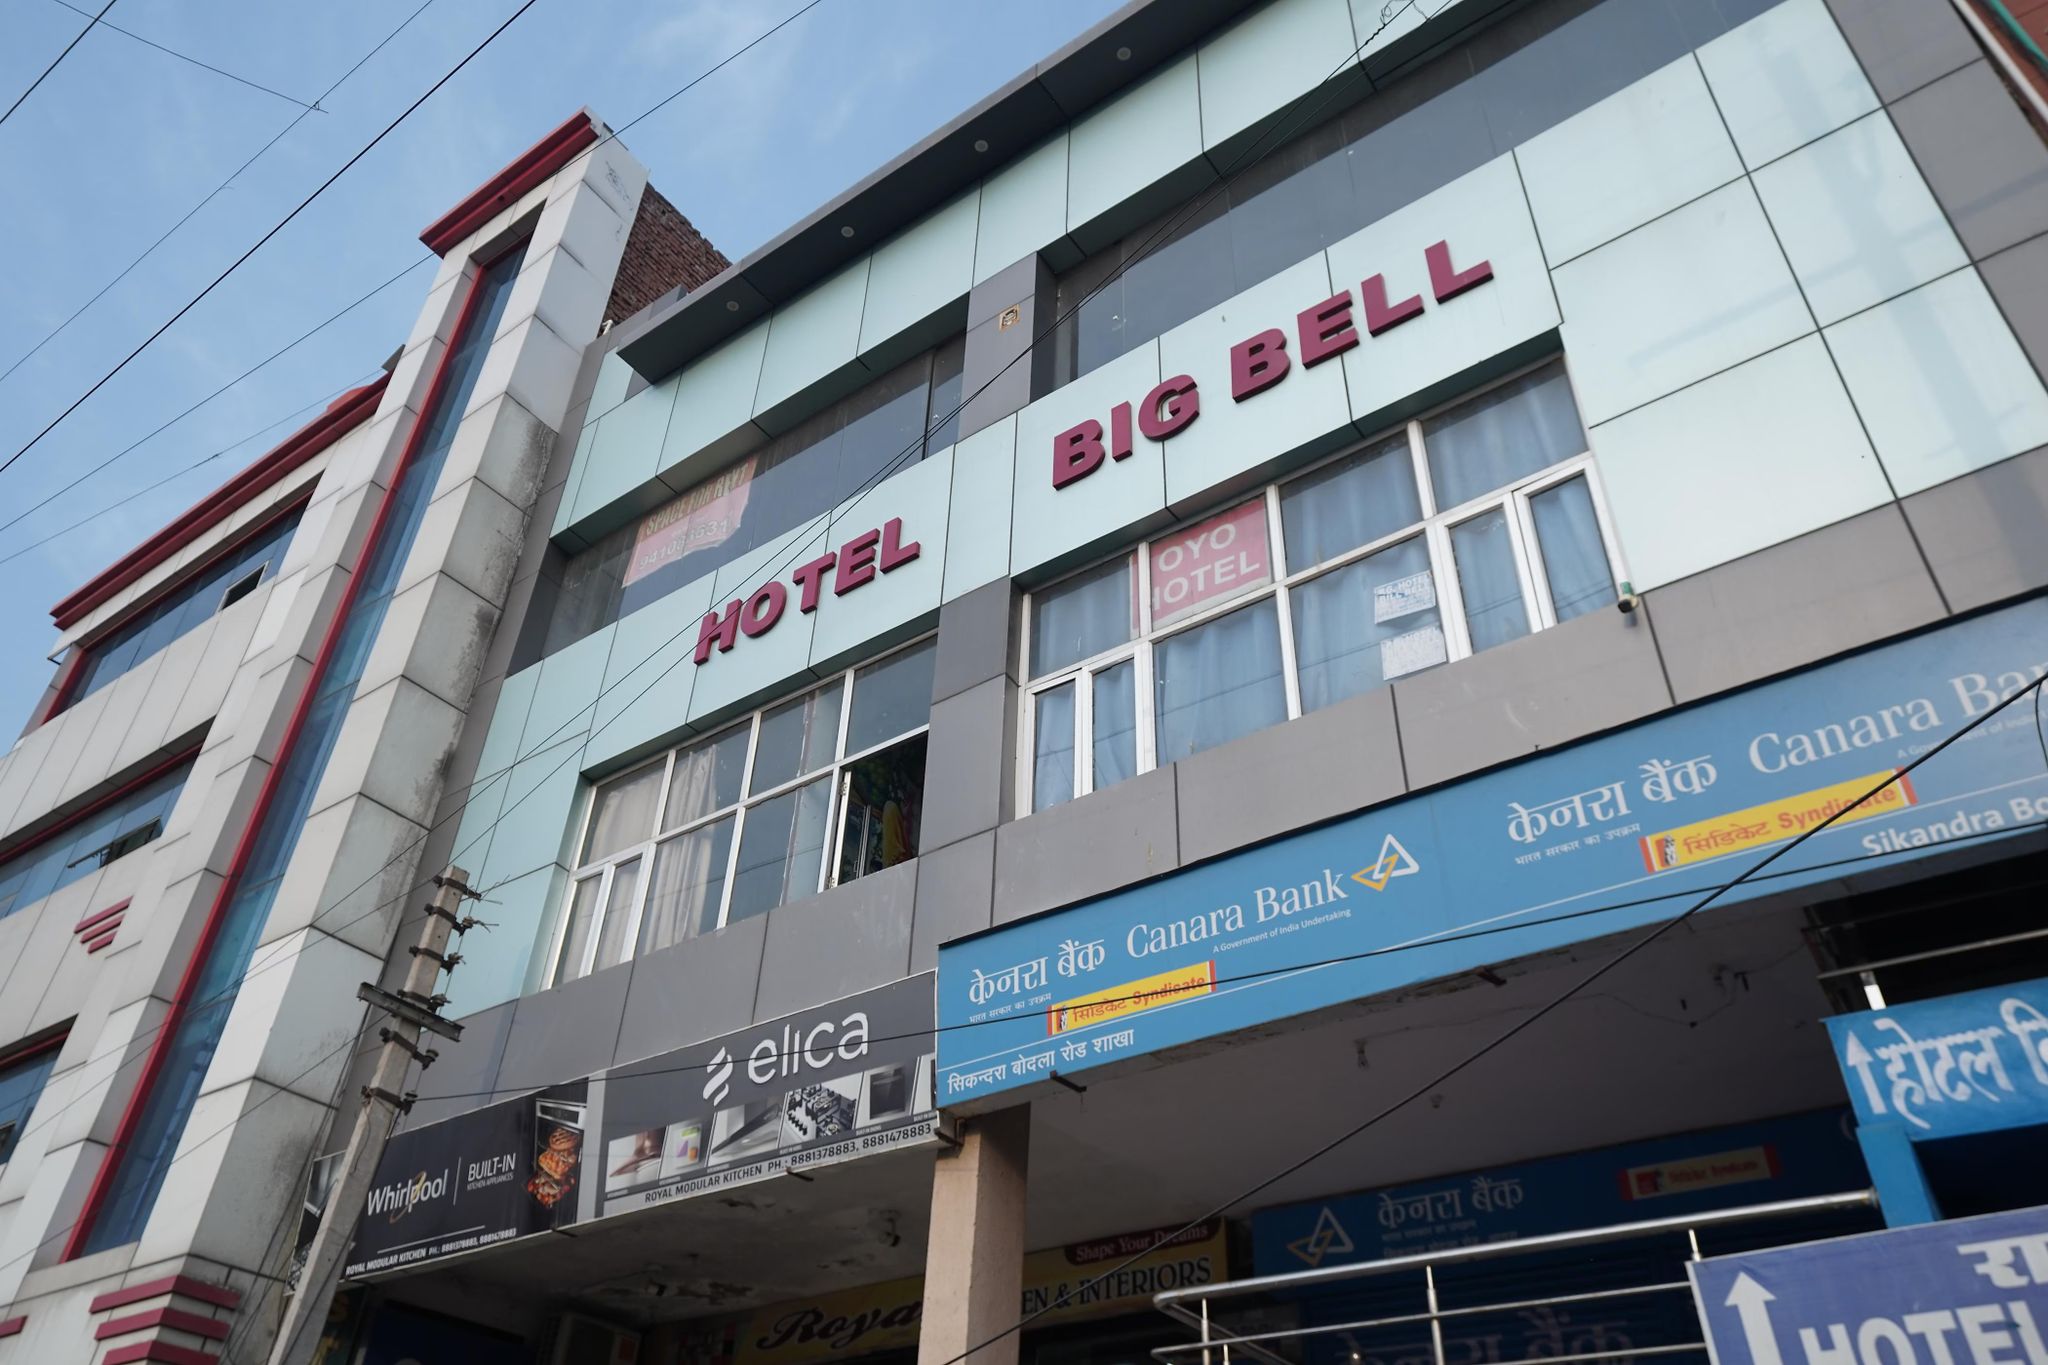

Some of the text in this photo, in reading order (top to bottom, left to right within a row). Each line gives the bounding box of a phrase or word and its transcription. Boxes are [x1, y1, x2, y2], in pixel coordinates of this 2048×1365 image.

[1052, 240, 1494, 491] BIG BELL
[1158, 523, 1236, 572] OYO
[694, 517, 920, 666] HOTEL
[1748, 698, 1944, 774] Canara
[1507, 754, 1717, 844] केनरा बैंक
[1862, 808, 2005, 856] Sikandra
[1126, 868, 1349, 958] Canara Bank
[1212, 908, 1352, 954] A Government of India Undertaking
[969, 938, 1106, 1006] केनरा बैंक
[1132, 976, 1206, 1008] Syndicate
[748, 1012, 868, 1084] elica
[947, 1028, 1134, 1095] सिकन्दरा बोदला रोड शाखा
[1873, 1017, 2015, 1130] होटल
[468, 1153, 516, 1182] BUILT-IN
[645, 1187, 673, 1203] ROYAL
[675, 1176, 720, 1196] MODULAR
[723, 1165, 762, 1184] KITCHEN
[790, 1141, 859, 1166] 8881378883,
[863, 1124, 931, 1149] 8881478883
[367, 1168, 448, 1217] Whirlpool
[1377, 1175, 1525, 1229] केनरा बैंक
[346, 1261, 365, 1276] ROYAL
[366, 1255, 398, 1271] MODULAR
[399, 1248, 426, 1263] KITCHEN
[1076, 1223, 1208, 1262] Shape Your Dreams
[1056, 1283, 1071, 1308] &
[1079, 1257, 1211, 1305] INTERIORS
[756, 1301, 922, 1350] Roya
